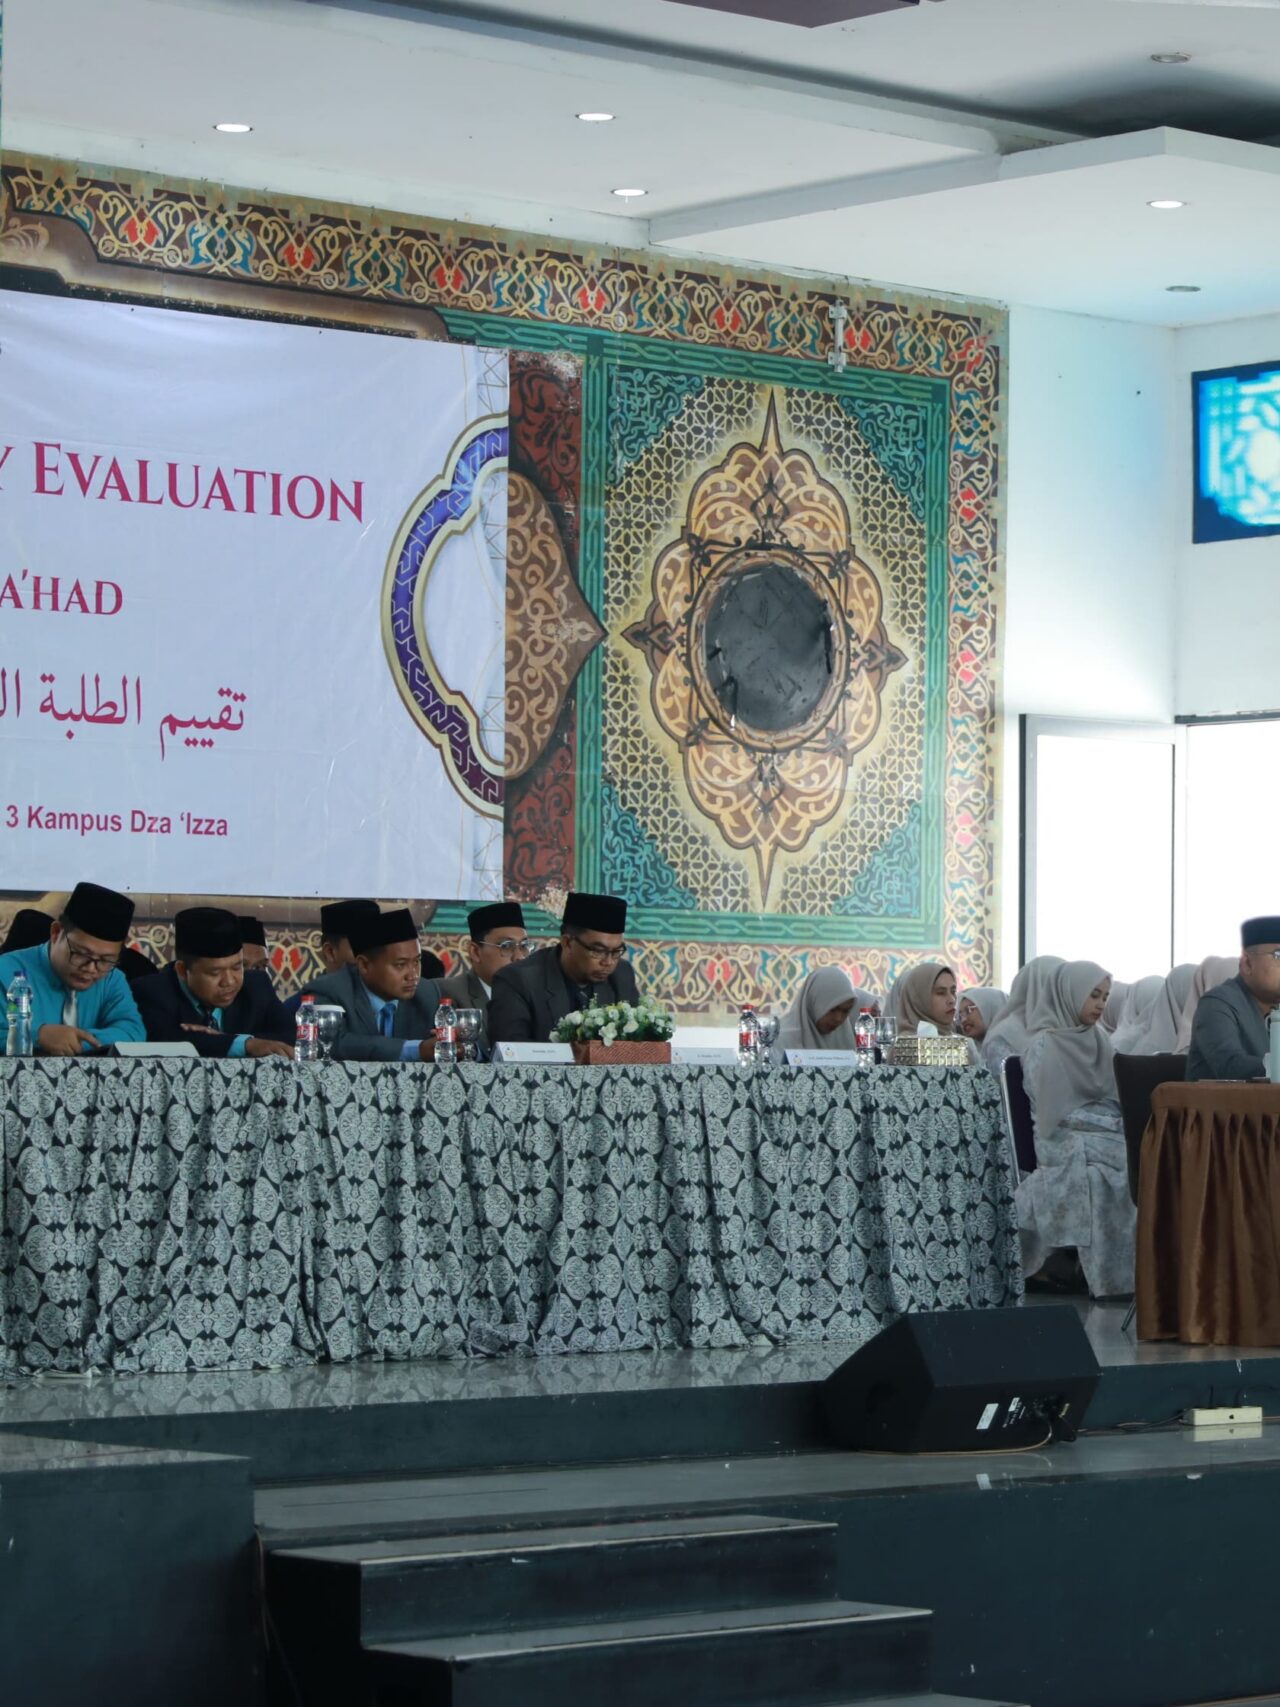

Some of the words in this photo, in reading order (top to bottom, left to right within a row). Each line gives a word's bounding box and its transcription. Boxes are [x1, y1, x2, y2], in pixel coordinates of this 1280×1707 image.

[33, 441, 365, 524] EVALUATION
[39, 672, 141, 740] الطلبة
[159, 687, 247, 762] تقييم
[6, 804, 19, 828] 3
[28, 805, 122, 836] Kampus
[130, 809, 172, 834] Dza
